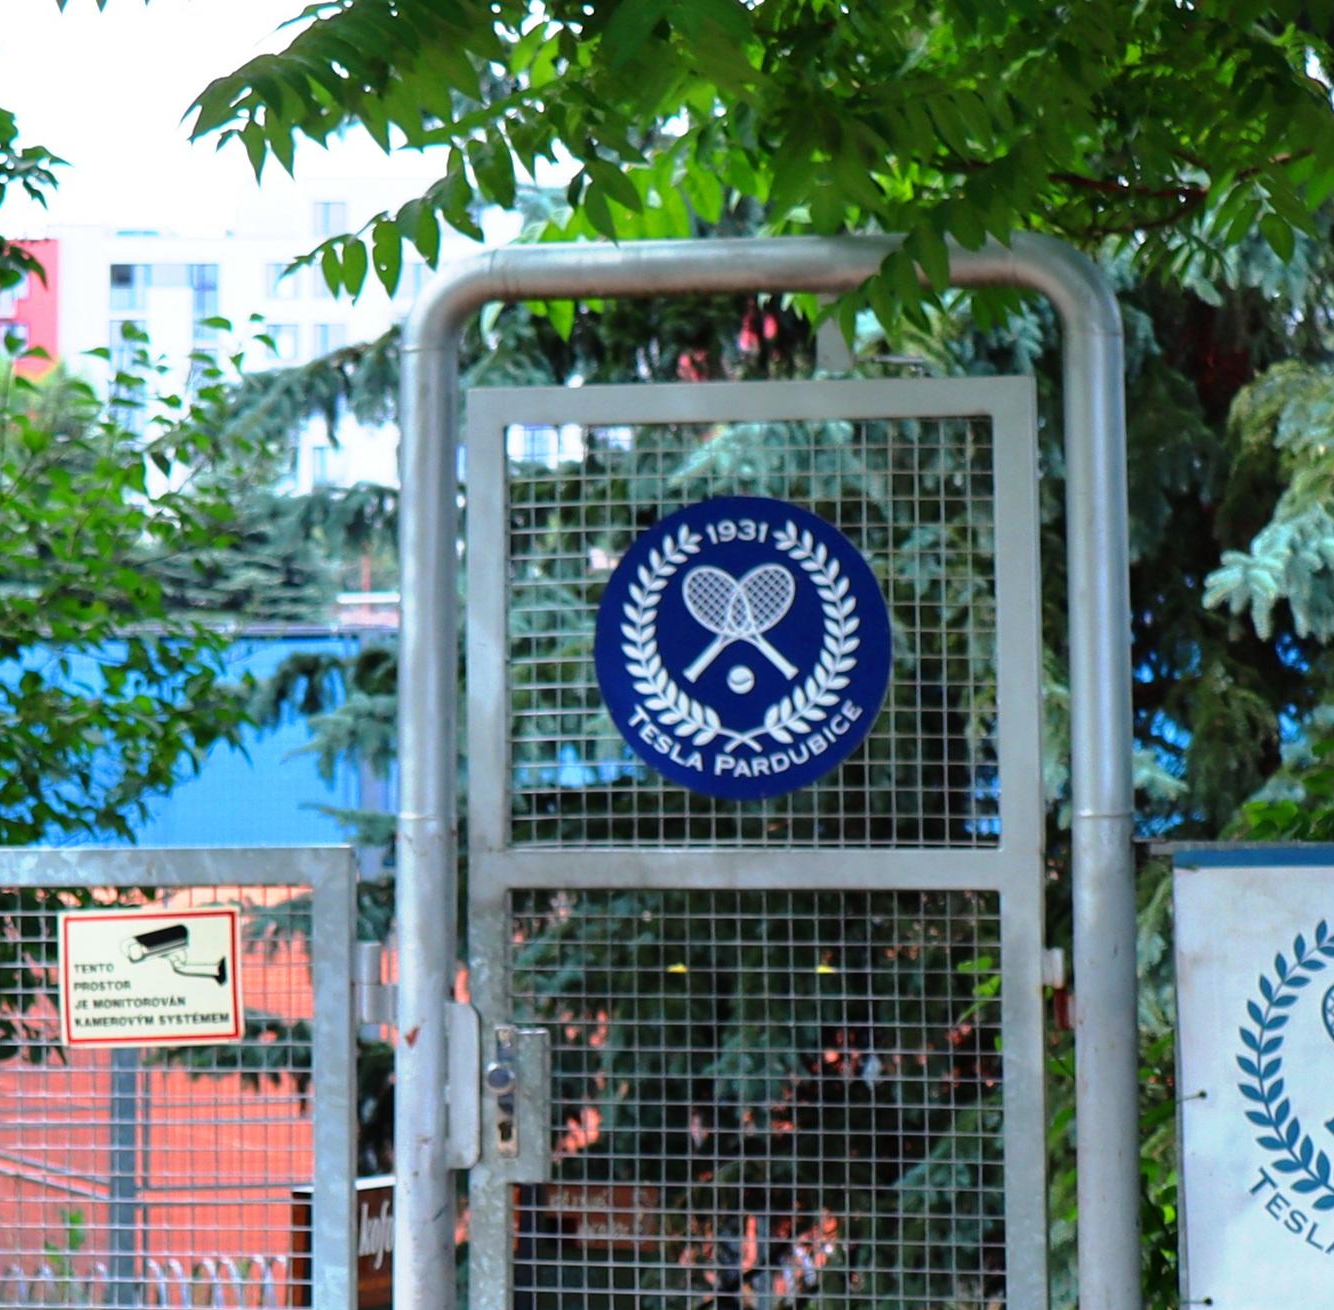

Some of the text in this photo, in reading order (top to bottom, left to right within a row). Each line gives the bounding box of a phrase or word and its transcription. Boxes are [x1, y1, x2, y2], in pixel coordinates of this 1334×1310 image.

[704, 518, 769, 545] 1931
[627, 699, 864, 779] TESLA PARDUBICE
[74, 963, 114, 974] TENTO
[74, 980, 131, 991] PROSTOR
[74, 995, 186, 1010] JE MONITOROVÁN
[75, 1011, 229, 1028] KAMEROVÝM SYSTÉMEM
